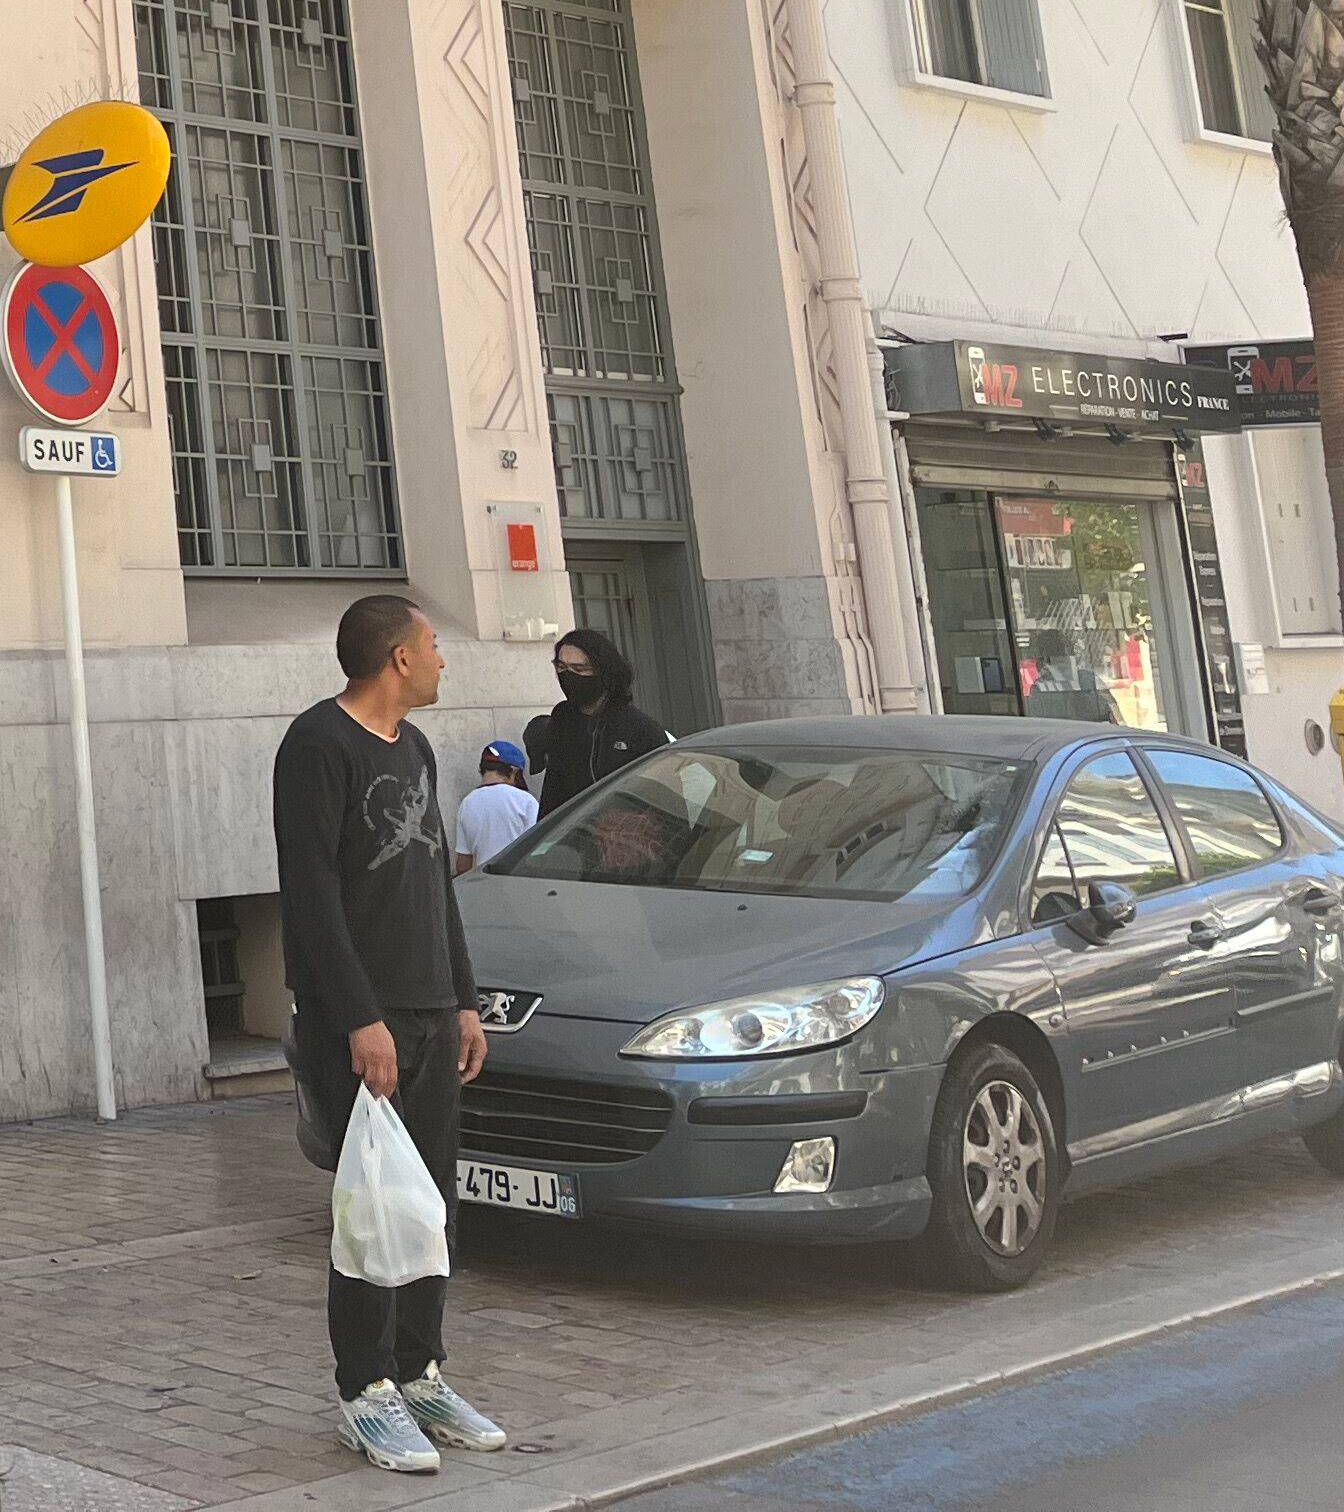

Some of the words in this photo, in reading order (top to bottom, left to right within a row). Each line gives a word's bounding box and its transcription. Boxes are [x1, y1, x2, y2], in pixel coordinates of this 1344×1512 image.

[982, 363, 1023, 408] MZ
[1031, 366, 1193, 407] ELECTRONICS
[1197, 395, 1230, 411] FRANCE
[33, 438, 85, 463] SAUF
[499, 449, 518, 470] 32
[511, 559, 536, 571] orange
[560, 1195, 576, 1213] 06
